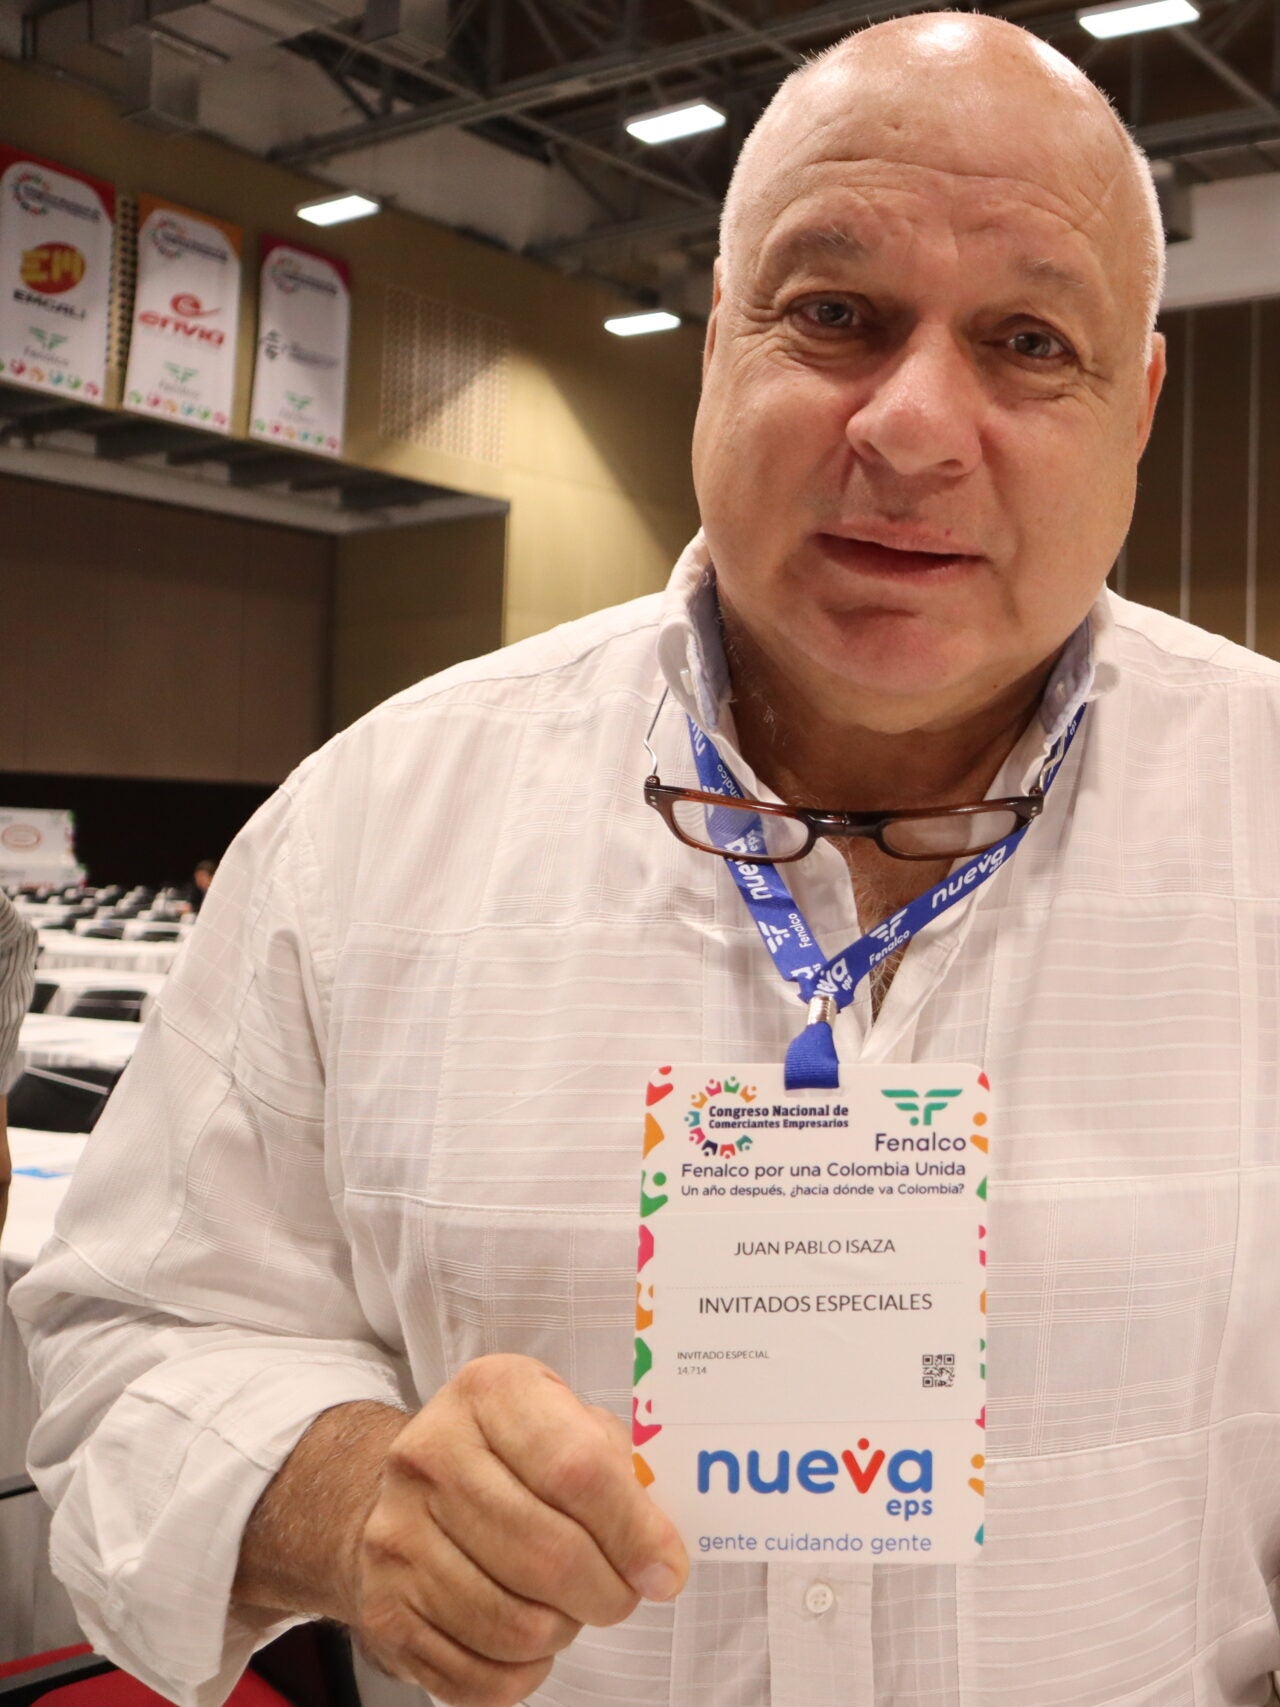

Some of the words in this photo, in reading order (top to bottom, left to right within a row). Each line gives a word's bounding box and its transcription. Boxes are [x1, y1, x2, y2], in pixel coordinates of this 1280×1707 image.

[138, 311, 225, 347] envia
[716, 763, 741, 799] enalco
[931, 844, 1007, 909] nueva
[788, 912, 813, 949] Fenalco
[869, 929, 911, 966] Fenalco
[708, 1105, 770, 1119] Congreso
[772, 1104, 830, 1117] Nacional
[833, 1104, 849, 1117] de
[708, 1119, 780, 1130] Comerciantes
[783, 1118, 849, 1130] Empresarios
[874, 1131, 967, 1152] Fenalco
[681, 1163, 750, 1178] Fenalco
[754, 1166, 785, 1180] por
[790, 1164, 821, 1177] una
[827, 1161, 910, 1177] Colombia
[915, 1161, 966, 1176] Unida
[681, 1184, 699, 1196] Un
[702, 1183, 727, 1196] año
[729, 1183, 786, 1198] después,
[790, 1183, 829, 1198] ¿hacia
[832, 1182, 875, 1196] dónde
[878, 1185, 895, 1196] va
[897, 1182, 965, 1196] Colombia?
[733, 1241, 780, 1257] JUAN
[784, 1239, 842, 1256] PABLO
[845, 1238, 896, 1254] ISAZA
[698, 1295, 811, 1315] INVITADOS
[815, 1293, 933, 1312] ESPECIALES
[677, 1350, 725, 1360] INVITADO
[725, 1349, 770, 1360] ESPECIAL
[677, 1365, 707, 1376] 14.714
[697, 1437, 934, 1495] nueva
[886, 1499, 934, 1522] eps
[698, 1534, 757, 1552] gente
[764, 1533, 864, 1552] cuidando
[870, 1533, 932, 1554] gente
